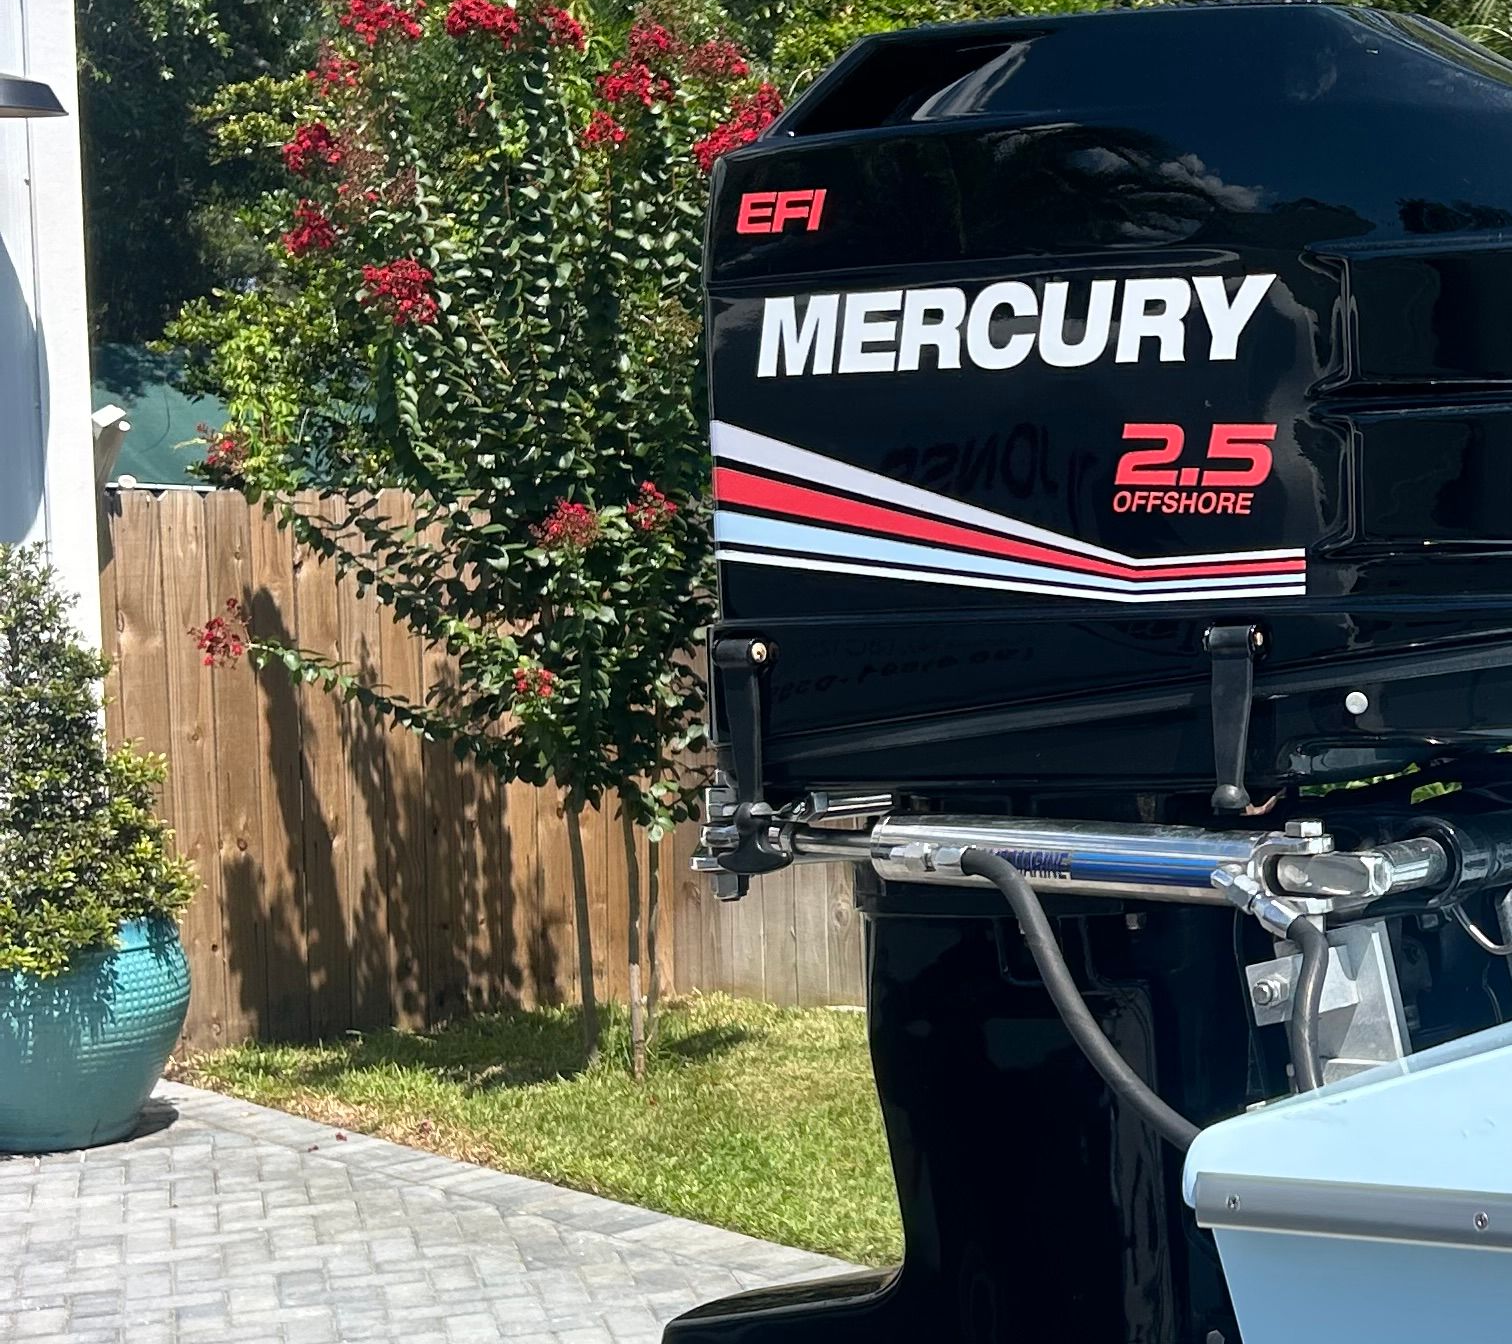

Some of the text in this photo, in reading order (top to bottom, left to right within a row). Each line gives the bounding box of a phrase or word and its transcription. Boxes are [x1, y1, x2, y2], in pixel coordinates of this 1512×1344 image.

[736, 188, 827, 234] EFI
[756, 273, 1278, 378] MERCURY
[1114, 423, 1278, 487] 2.5
[1112, 490, 1255, 515] OFFSHORE
